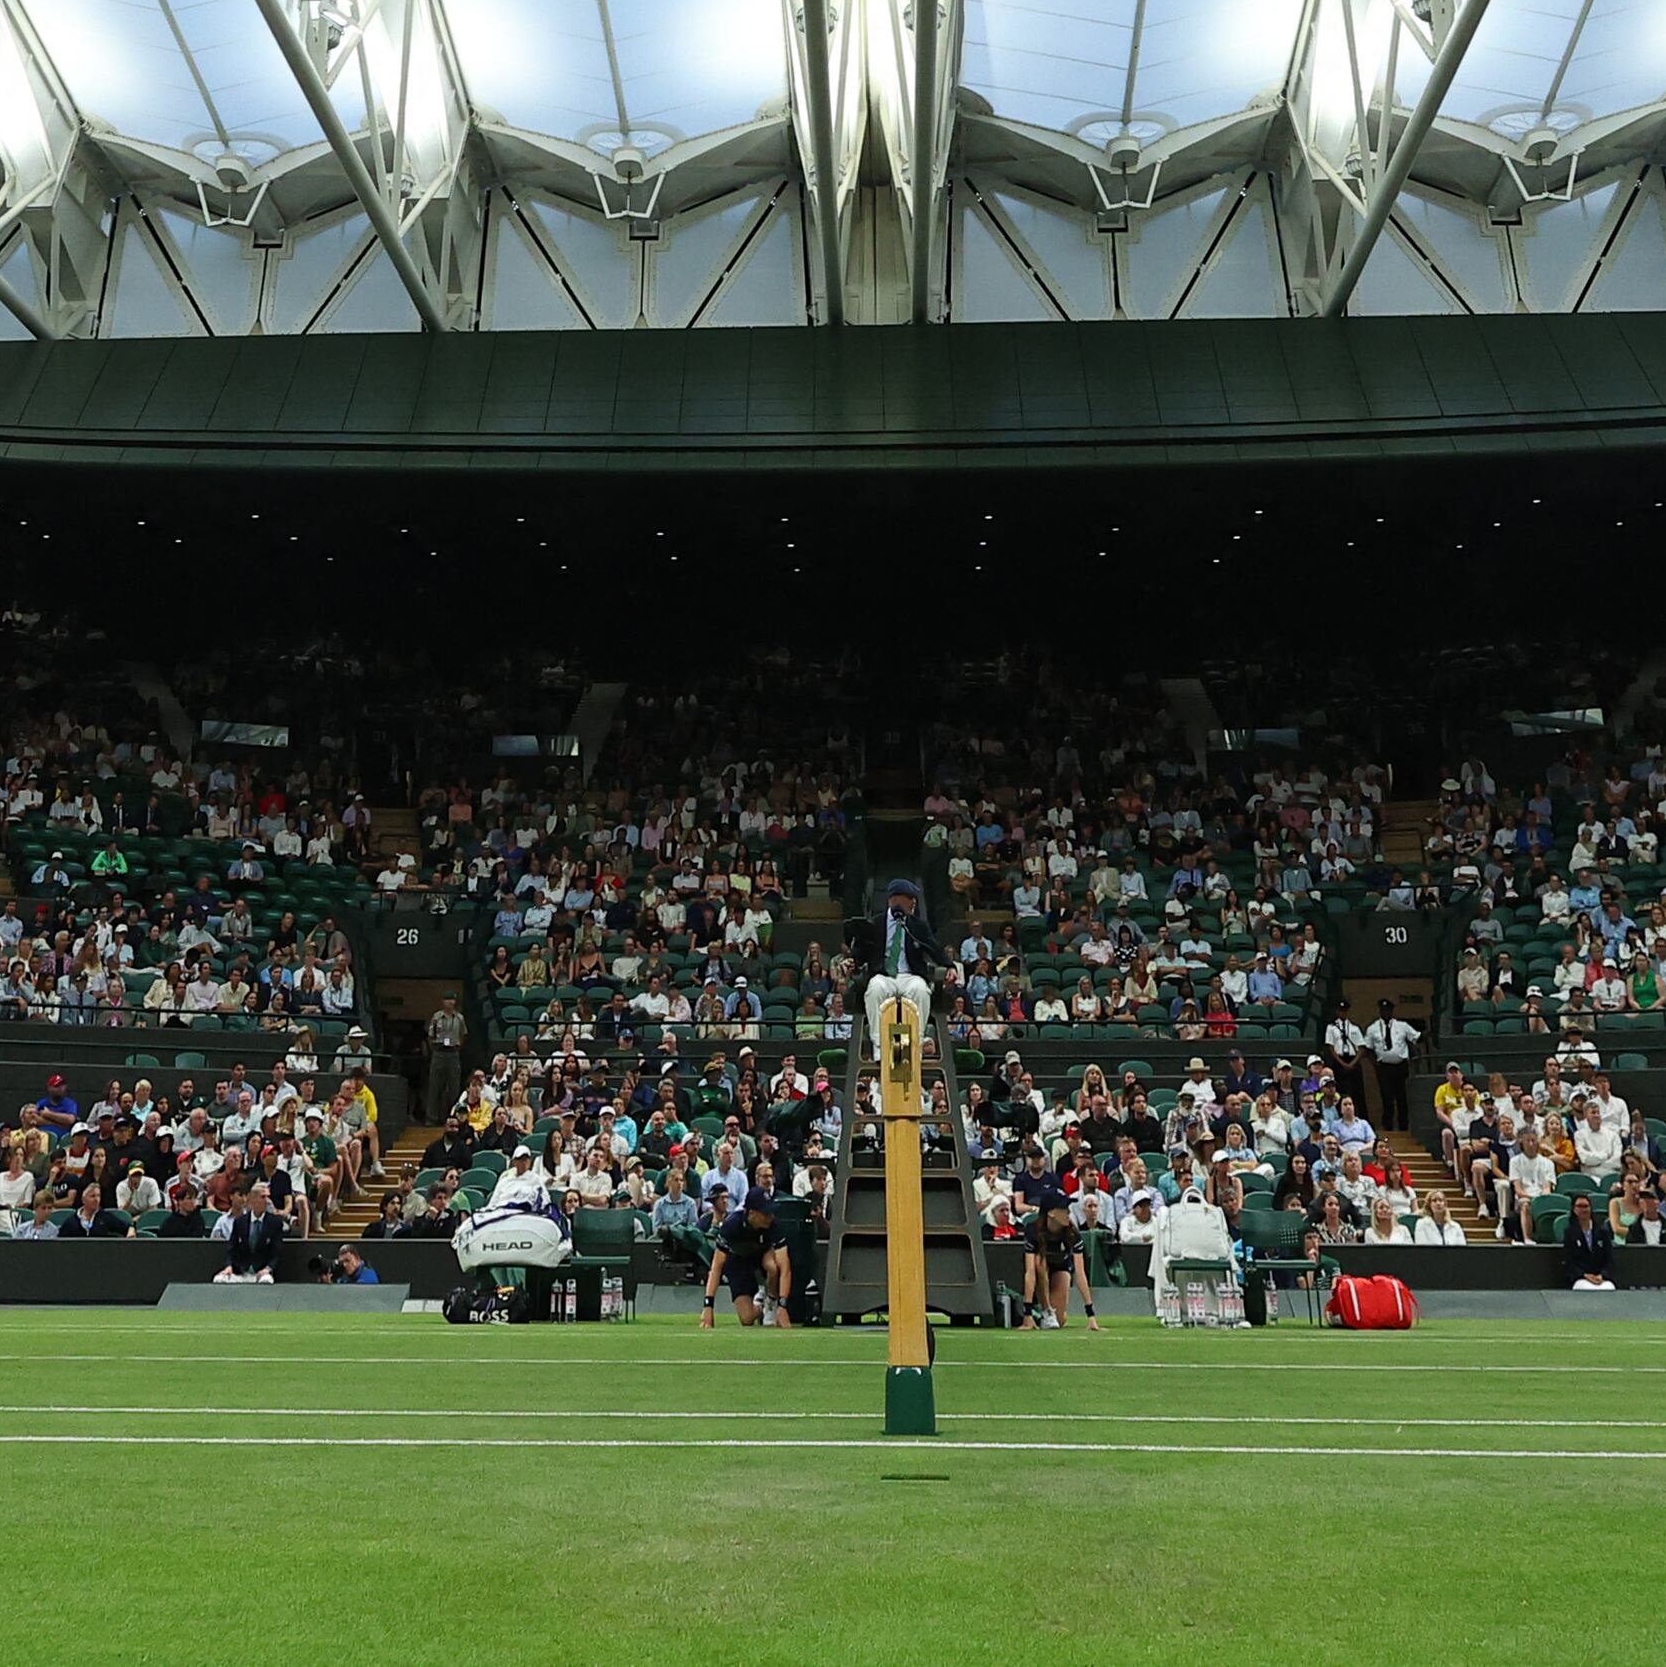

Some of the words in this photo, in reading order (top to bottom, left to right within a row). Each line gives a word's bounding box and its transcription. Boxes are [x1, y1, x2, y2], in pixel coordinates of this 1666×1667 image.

[396, 928, 419, 945] 26
[1385, 927, 1408, 944] 30
[482, 1241, 533, 1252] HEAD
[469, 1309, 509, 1323] BOSS
